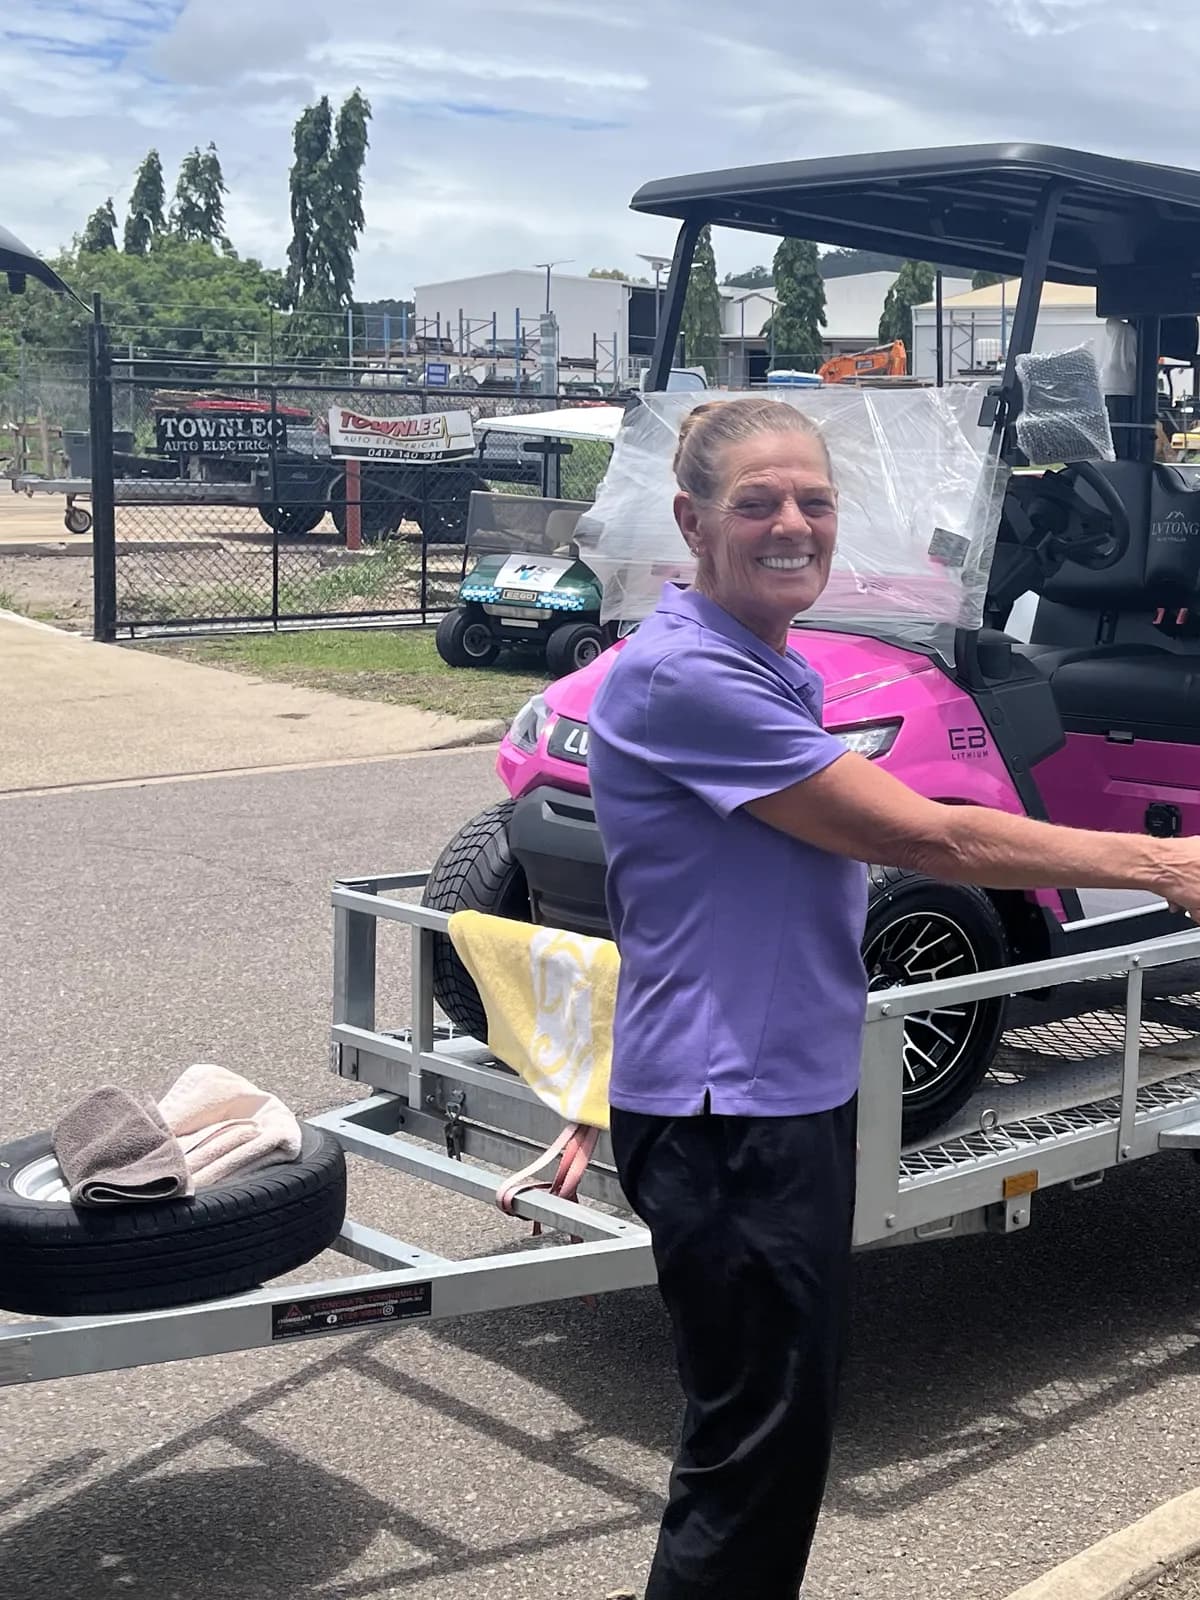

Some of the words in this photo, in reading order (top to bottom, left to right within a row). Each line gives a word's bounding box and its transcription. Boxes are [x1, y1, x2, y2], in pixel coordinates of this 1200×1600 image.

[160, 417, 284, 438] TOWNLEC
[340, 411, 441, 437] TOWNLEC
[163, 440, 199, 452] AUTO
[948, 727, 987, 751] EB
[951, 750, 989, 761] LITHIUM
